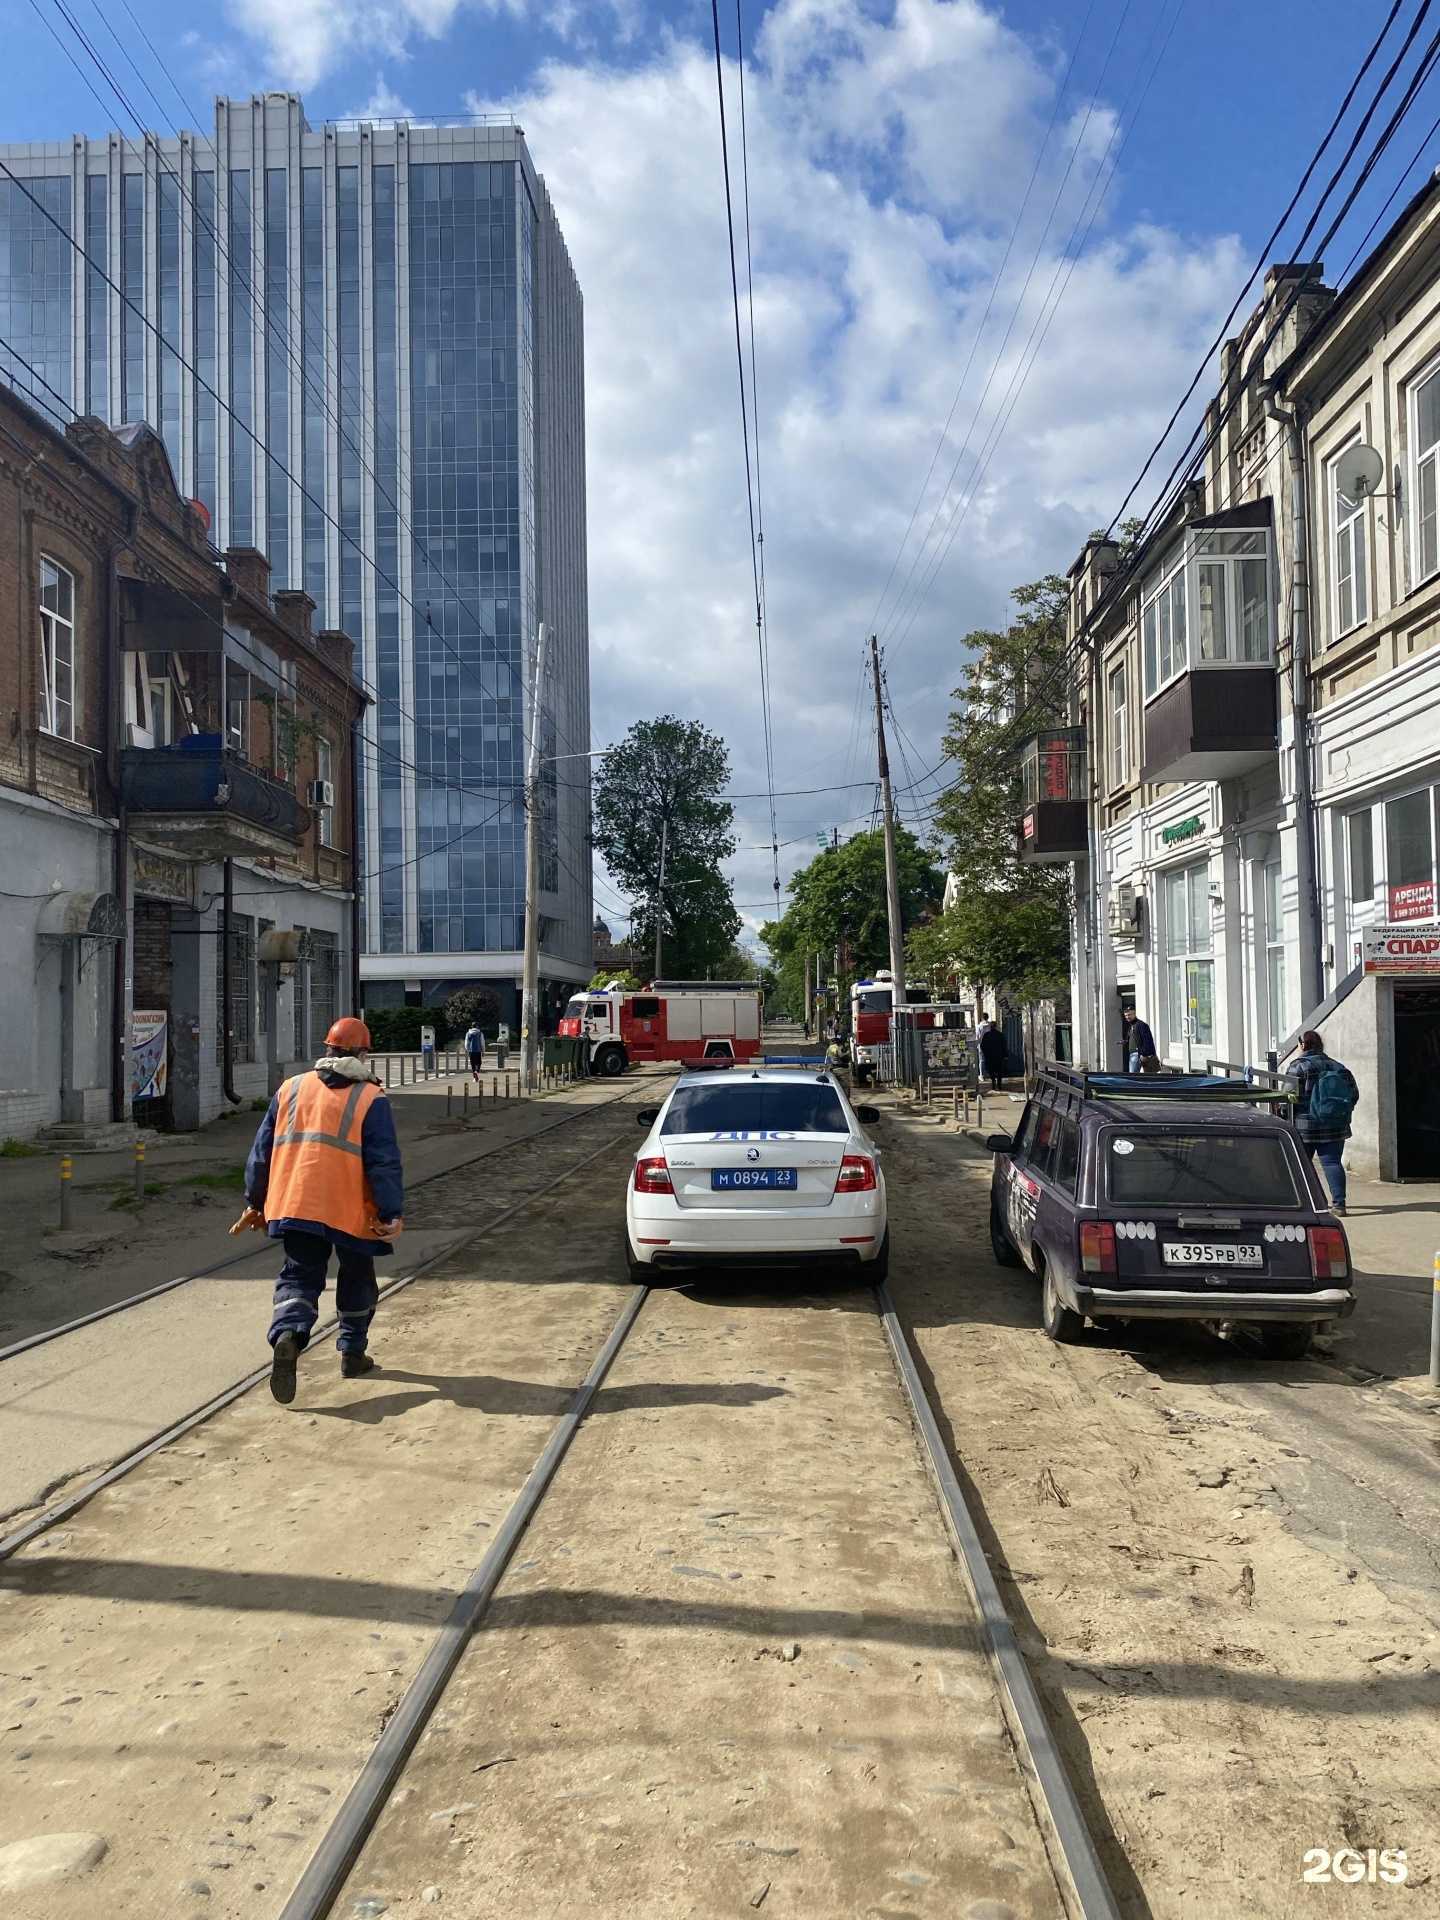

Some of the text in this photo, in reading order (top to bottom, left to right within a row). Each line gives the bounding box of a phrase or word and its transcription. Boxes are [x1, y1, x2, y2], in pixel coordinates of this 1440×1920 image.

[1395, 886, 1433, 905] АРЕНДА
[709, 1131, 796, 1141] ДПС
[733, 1171, 768, 1185] 0894
[776, 1170, 791, 1180] 23
[1240, 1246, 1256, 1258] 93
